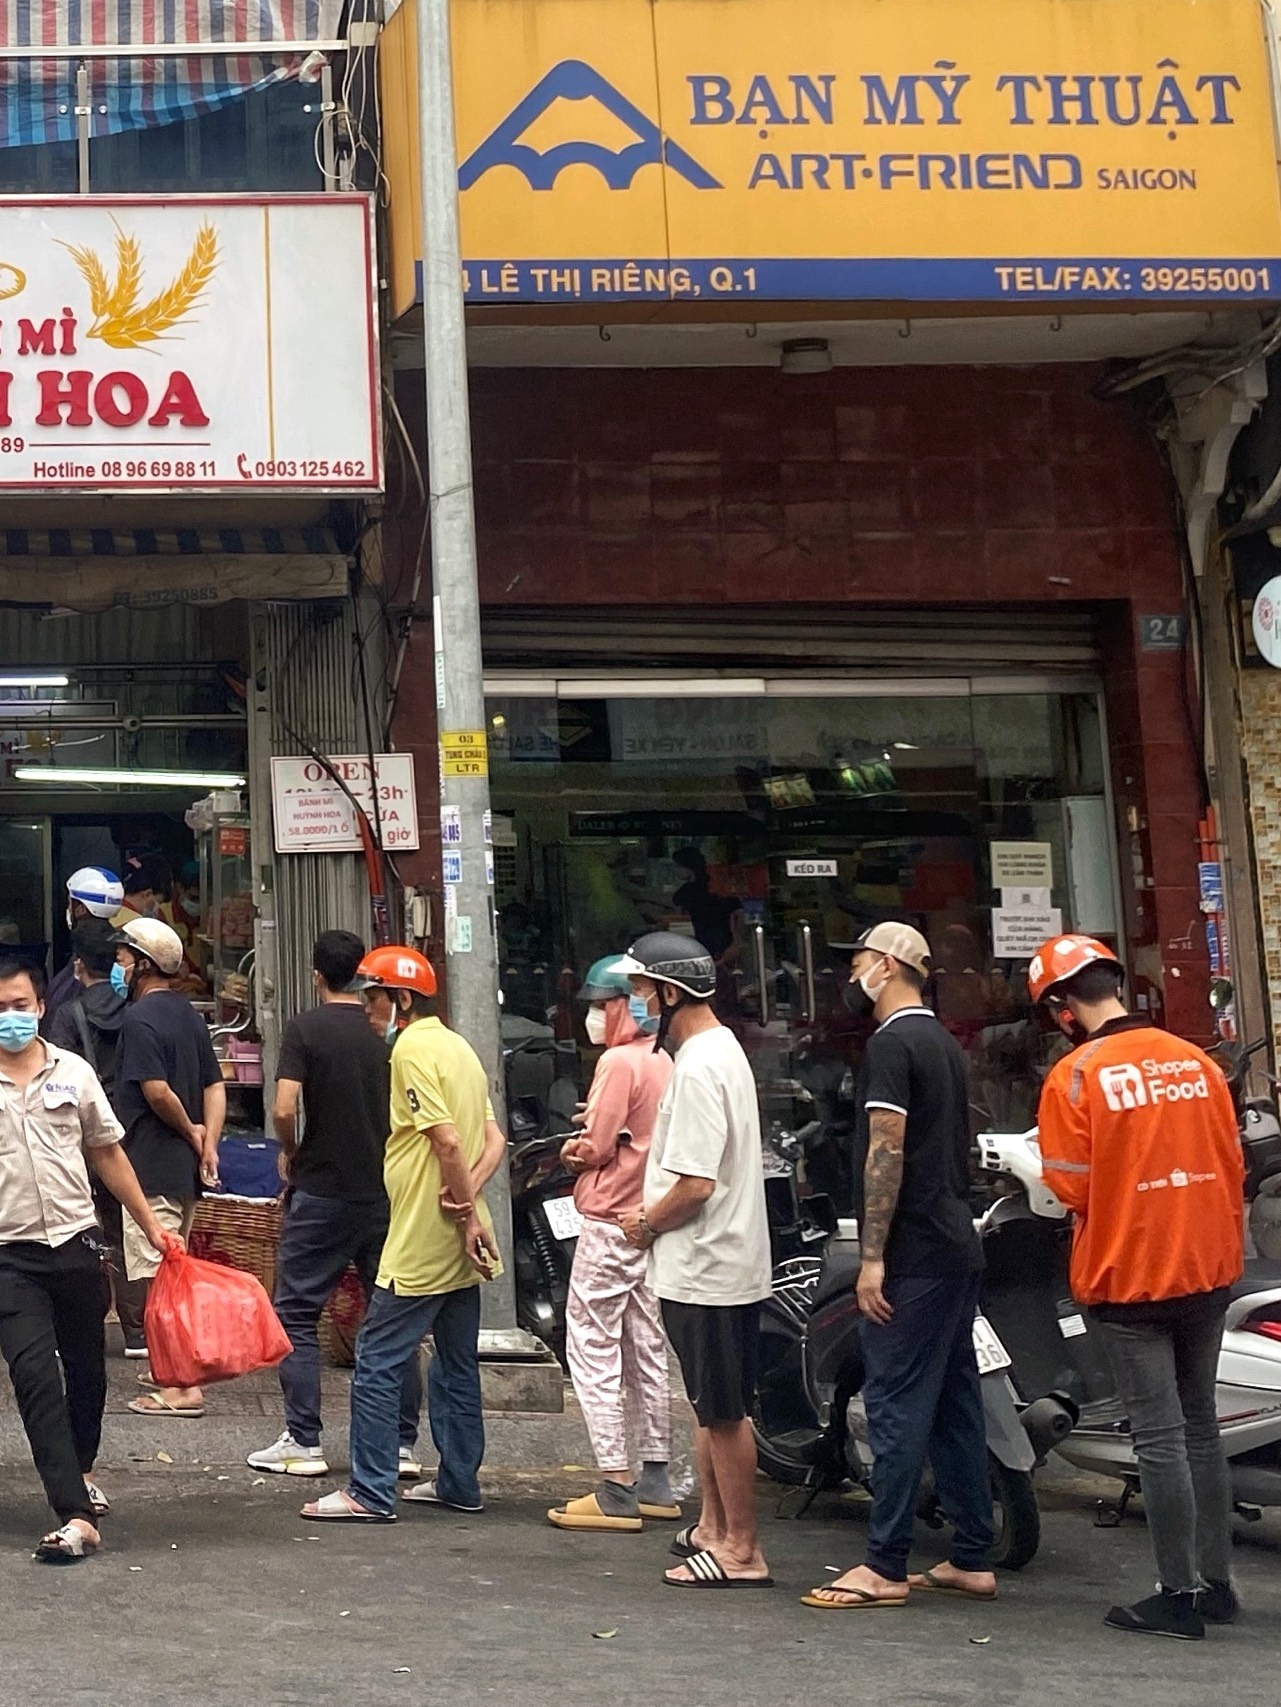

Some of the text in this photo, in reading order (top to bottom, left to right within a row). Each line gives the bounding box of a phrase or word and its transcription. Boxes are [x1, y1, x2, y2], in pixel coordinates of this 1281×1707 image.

[686, 58, 1241, 140] BẠN MỸ THUẬT
[1098, 168, 1197, 190] SAIGON
[481, 262, 521, 292] LÊ
[530, 268, 581, 297] THỊ
[591, 262, 701, 297] RIÊNG,
[710, 267, 757, 292] Q.1
[994, 266, 1270, 292] TEL/FAX: 39255001
[17, 307, 77, 356] MÌ
[35, 370, 211, 427] HOA
[34, 461, 96, 478] Hotline
[1149, 618, 1180, 641] 24
[456, 763, 480, 773] LTR
[1141, 1058, 1202, 1078] Shopee
[1148, 1076, 1209, 1105] Food
